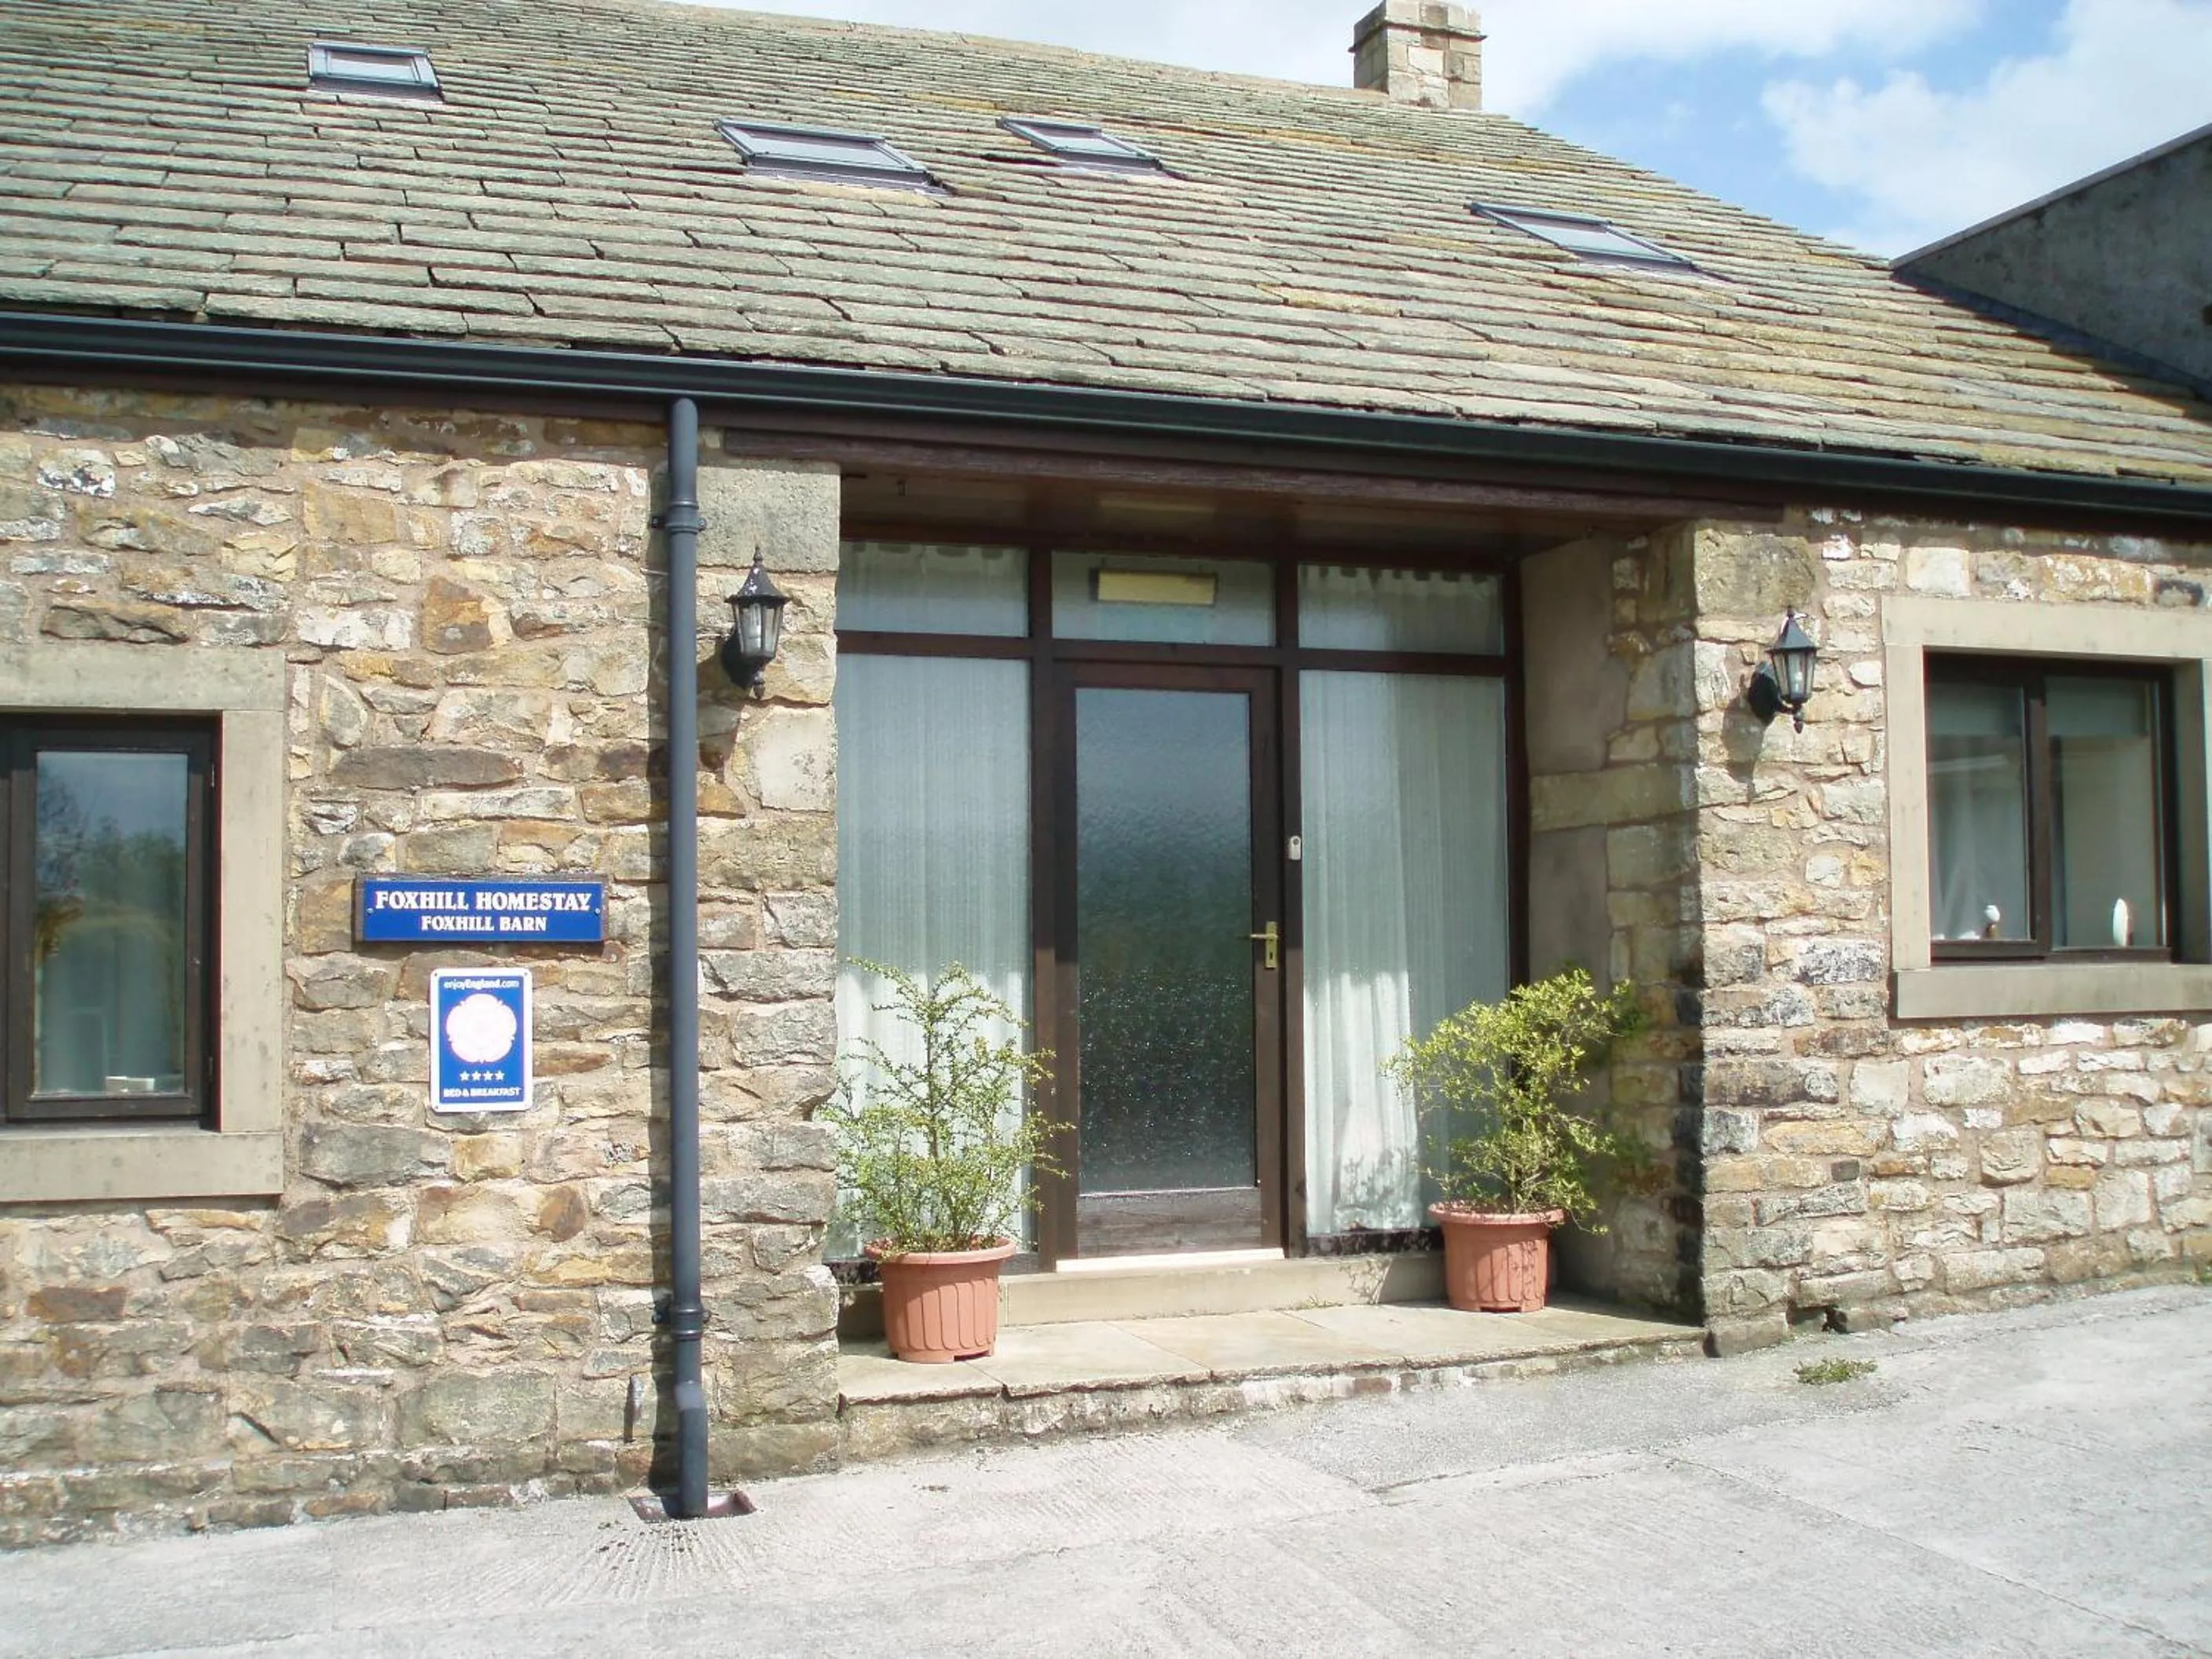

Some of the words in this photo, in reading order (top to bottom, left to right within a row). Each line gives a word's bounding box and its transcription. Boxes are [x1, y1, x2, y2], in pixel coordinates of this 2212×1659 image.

[375, 891, 469, 910] FOXHILL
[476, 892, 591, 911] HOMESTAY
[421, 916, 494, 932] FOXHILL
[500, 917, 547, 932] BARN
